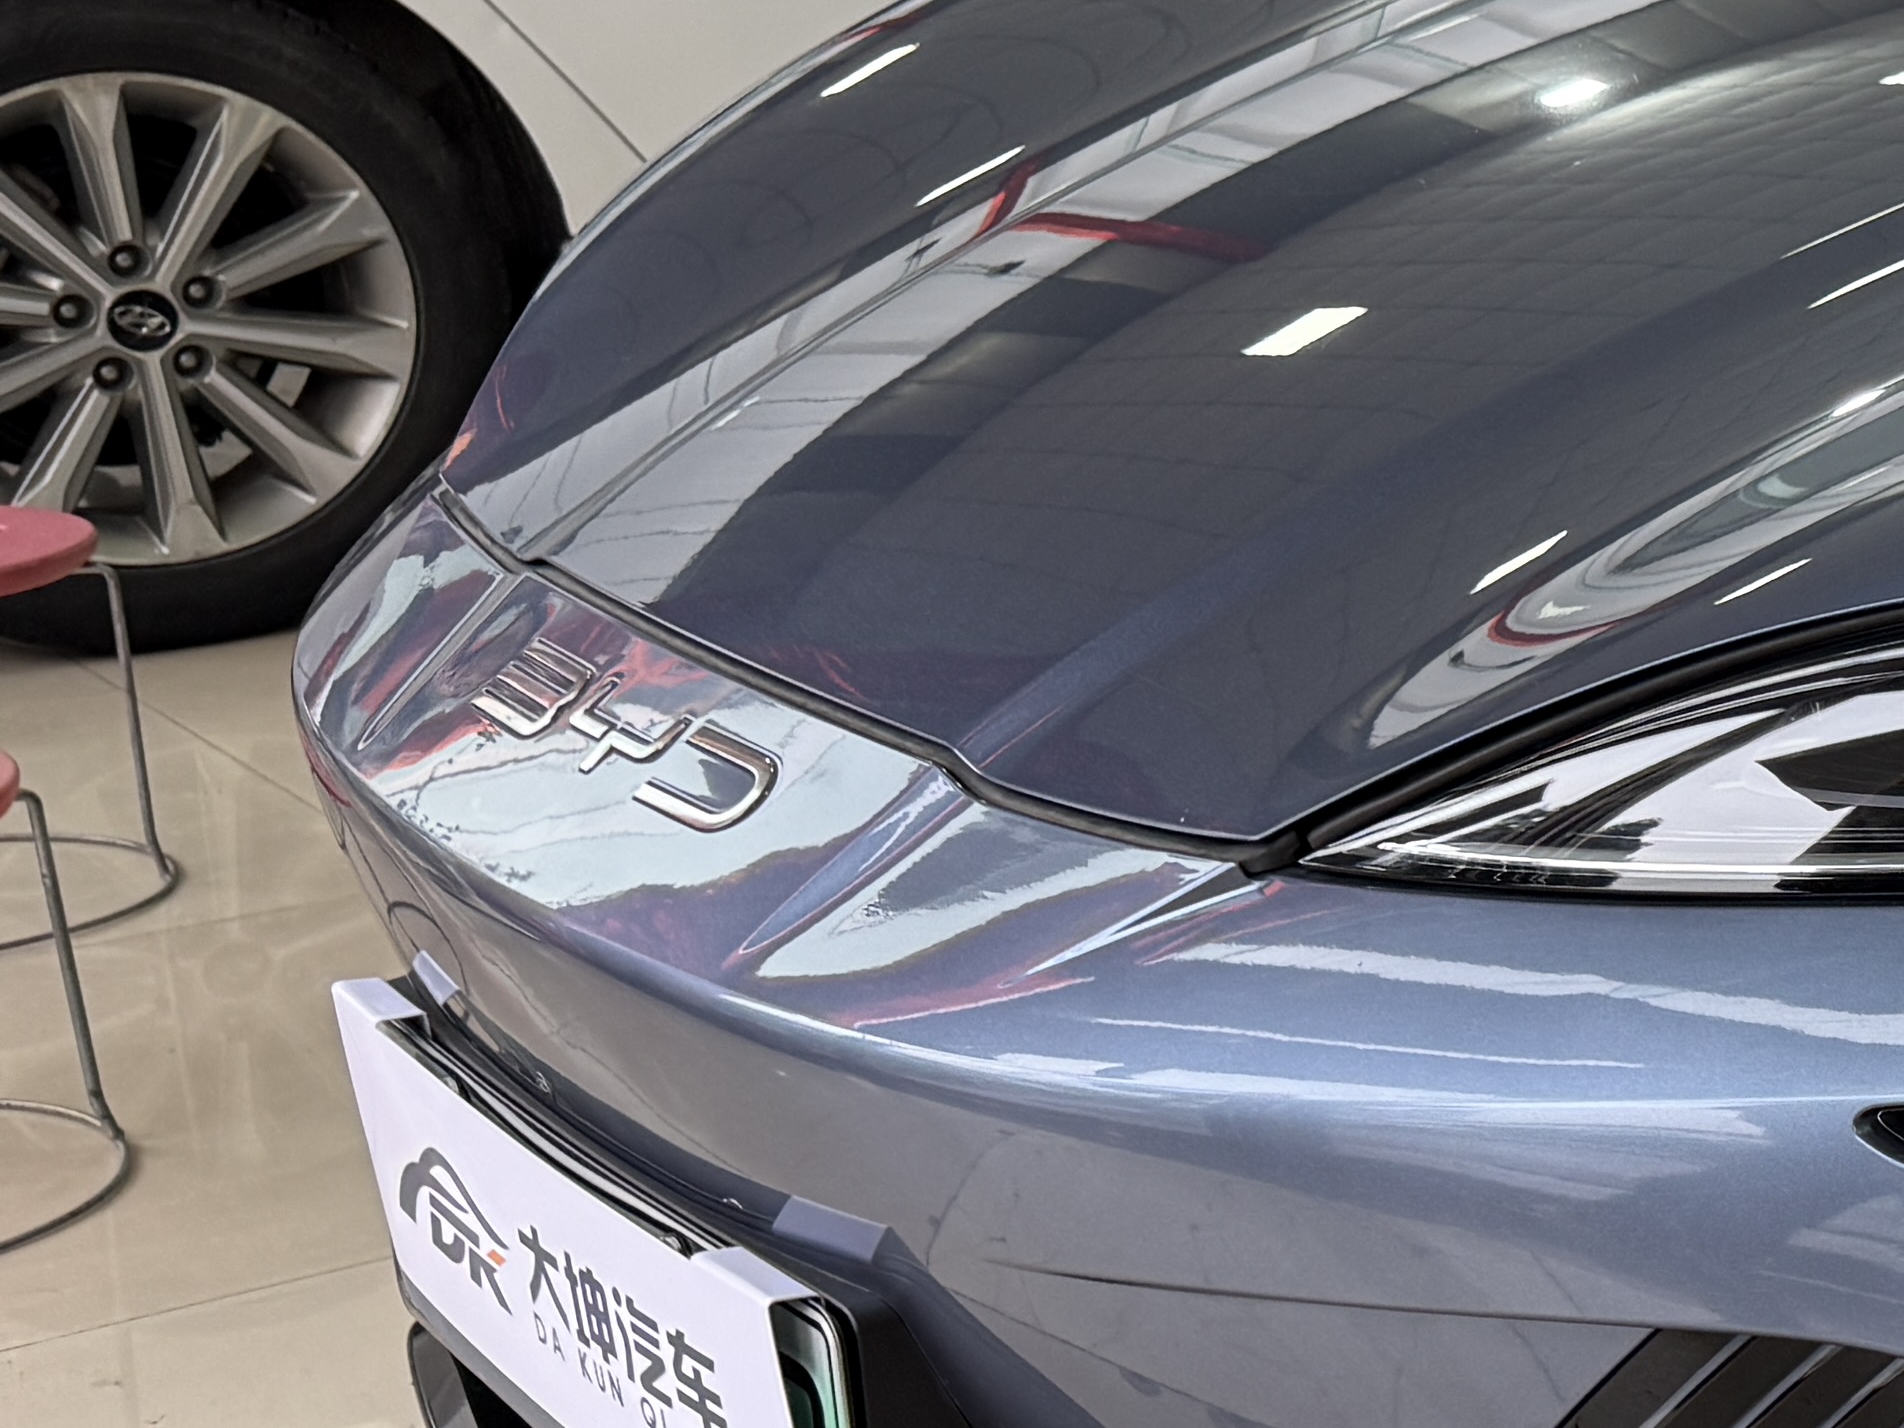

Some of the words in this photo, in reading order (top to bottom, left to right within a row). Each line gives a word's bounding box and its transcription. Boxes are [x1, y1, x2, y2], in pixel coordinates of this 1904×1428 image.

[473, 633, 784, 833] BYD
[533, 1310, 567, 1366] DA
[579, 1349, 625, 1409] KUN
